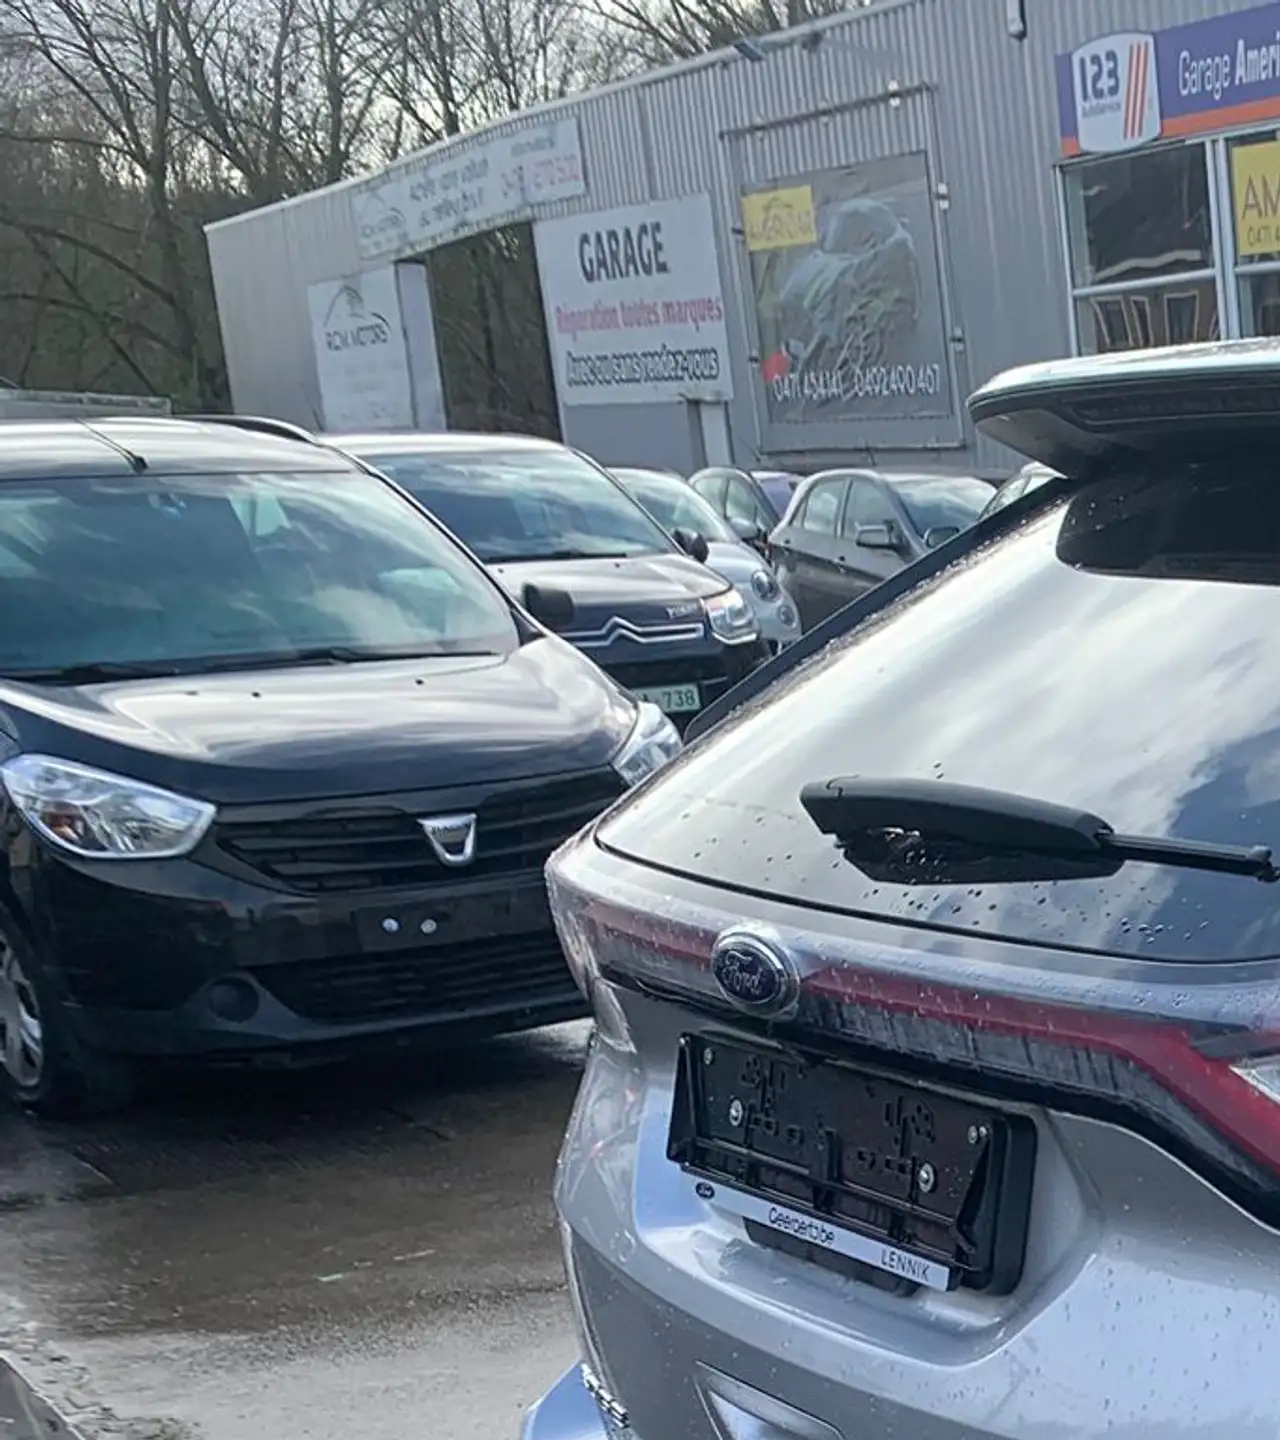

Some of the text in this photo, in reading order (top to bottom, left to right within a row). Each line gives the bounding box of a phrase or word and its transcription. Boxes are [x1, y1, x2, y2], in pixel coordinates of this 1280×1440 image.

[1178, 48, 1231, 100] Garage
[578, 221, 671, 284] GARAGE
[620, 299, 661, 329] toutes
[661, 296, 723, 333] marques
[641, 342, 720, 383] rendez-vous
[881, 1248, 930, 1283] LENNIK
